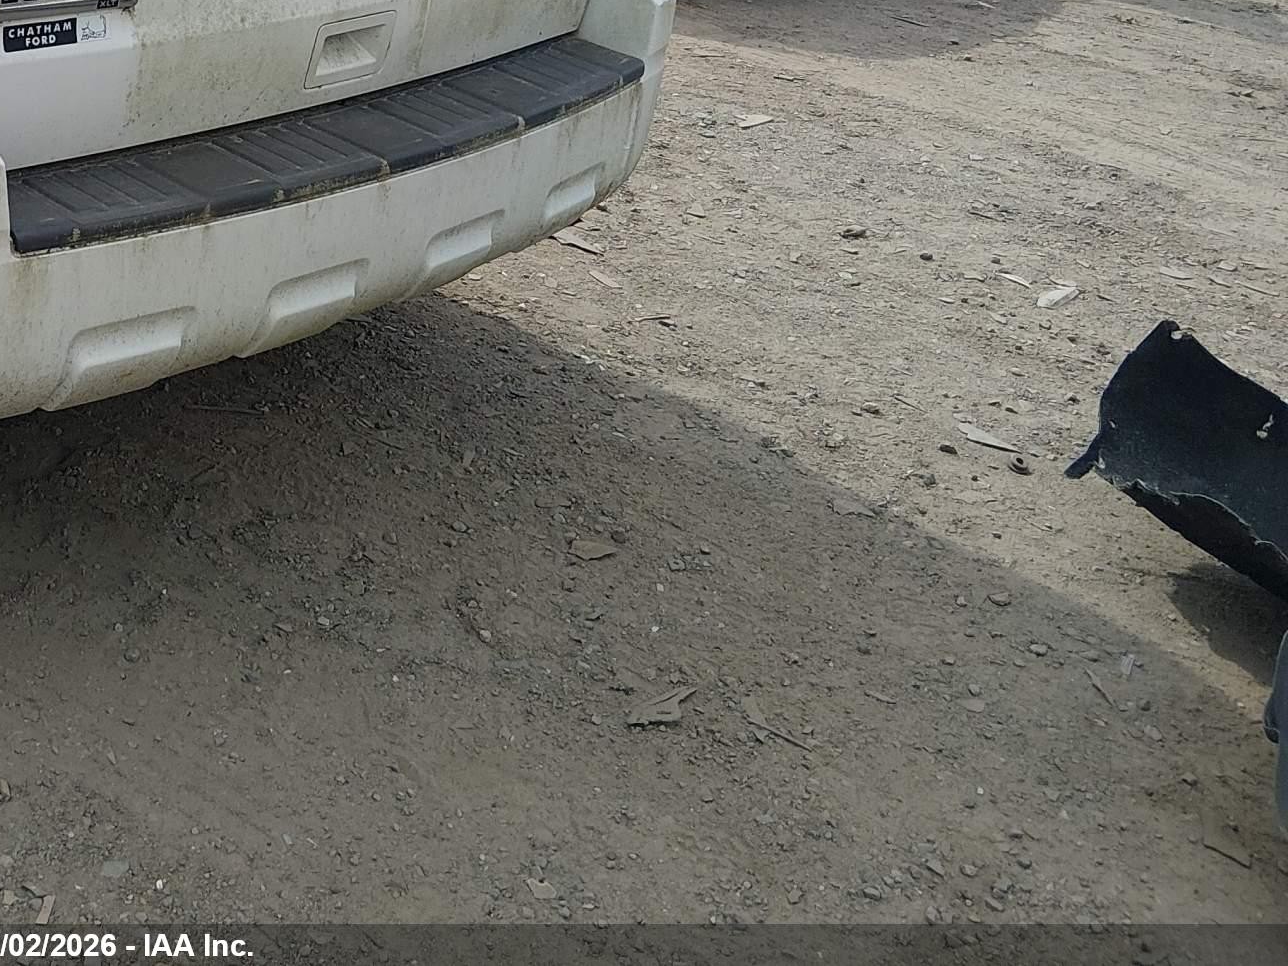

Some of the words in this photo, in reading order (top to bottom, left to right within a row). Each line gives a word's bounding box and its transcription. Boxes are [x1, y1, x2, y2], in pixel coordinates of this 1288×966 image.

[99, 0, 117, 9] XLT
[8, 21, 73, 38] CHATHAM
[25, 35, 57, 48] FORD
